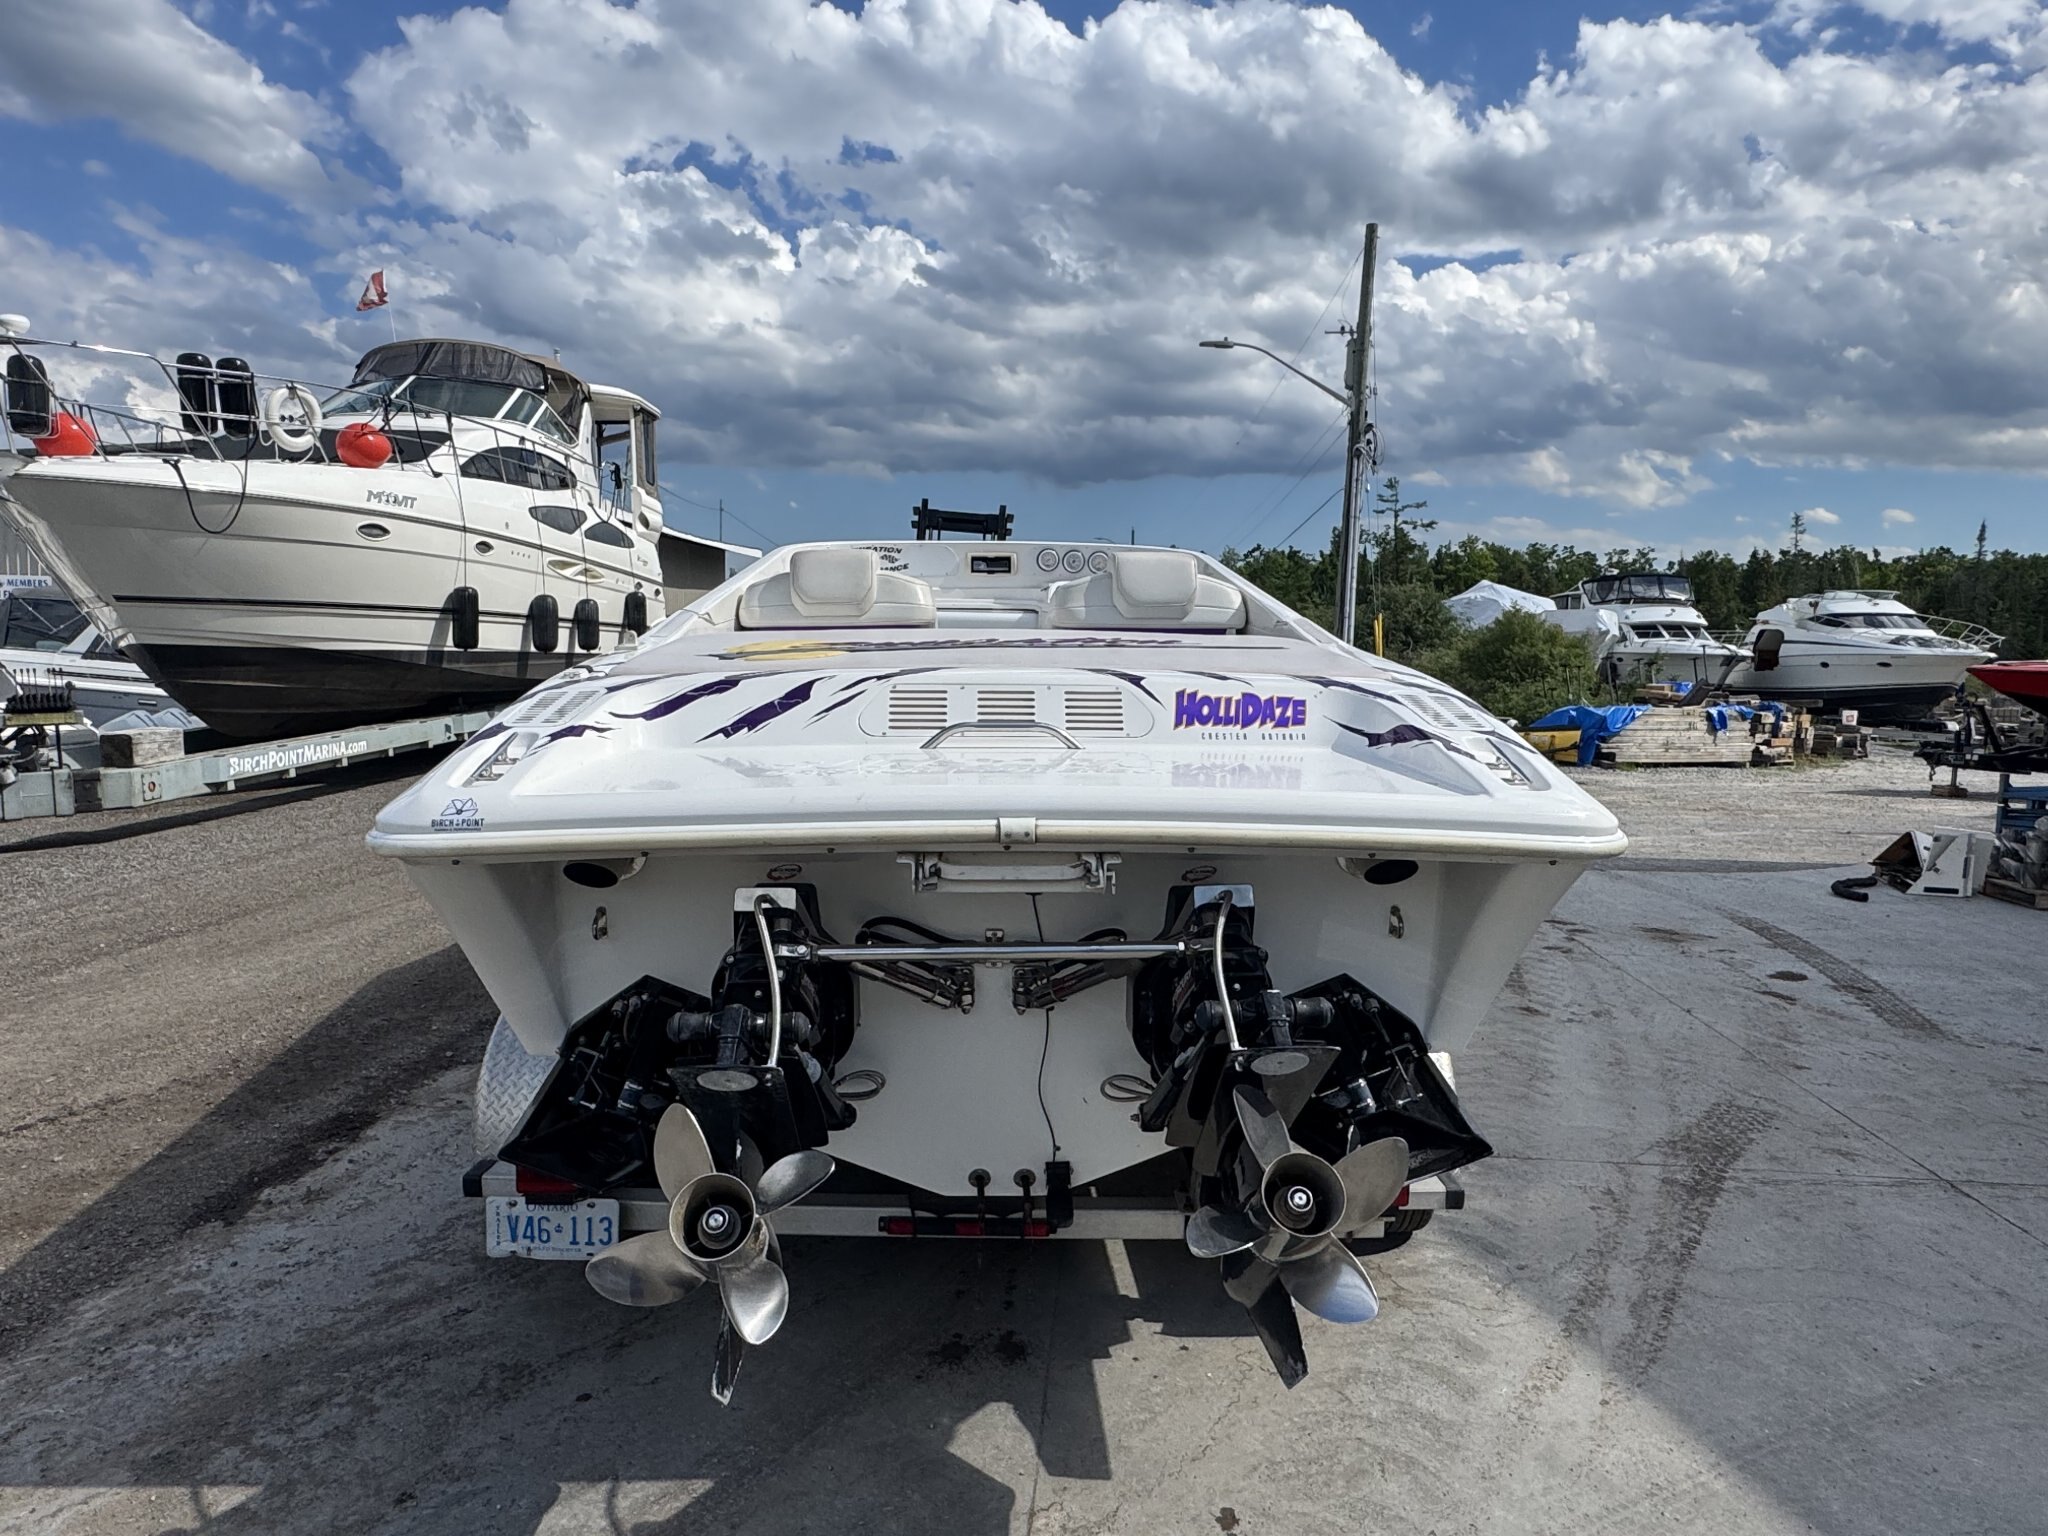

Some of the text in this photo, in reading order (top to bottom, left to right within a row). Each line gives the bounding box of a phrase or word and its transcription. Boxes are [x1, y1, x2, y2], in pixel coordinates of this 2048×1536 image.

[6, 579, 49, 587] MEMBERS
[431, 818, 485, 828] BIRCH POINT
[506, 1214, 613, 1246] V46 113
